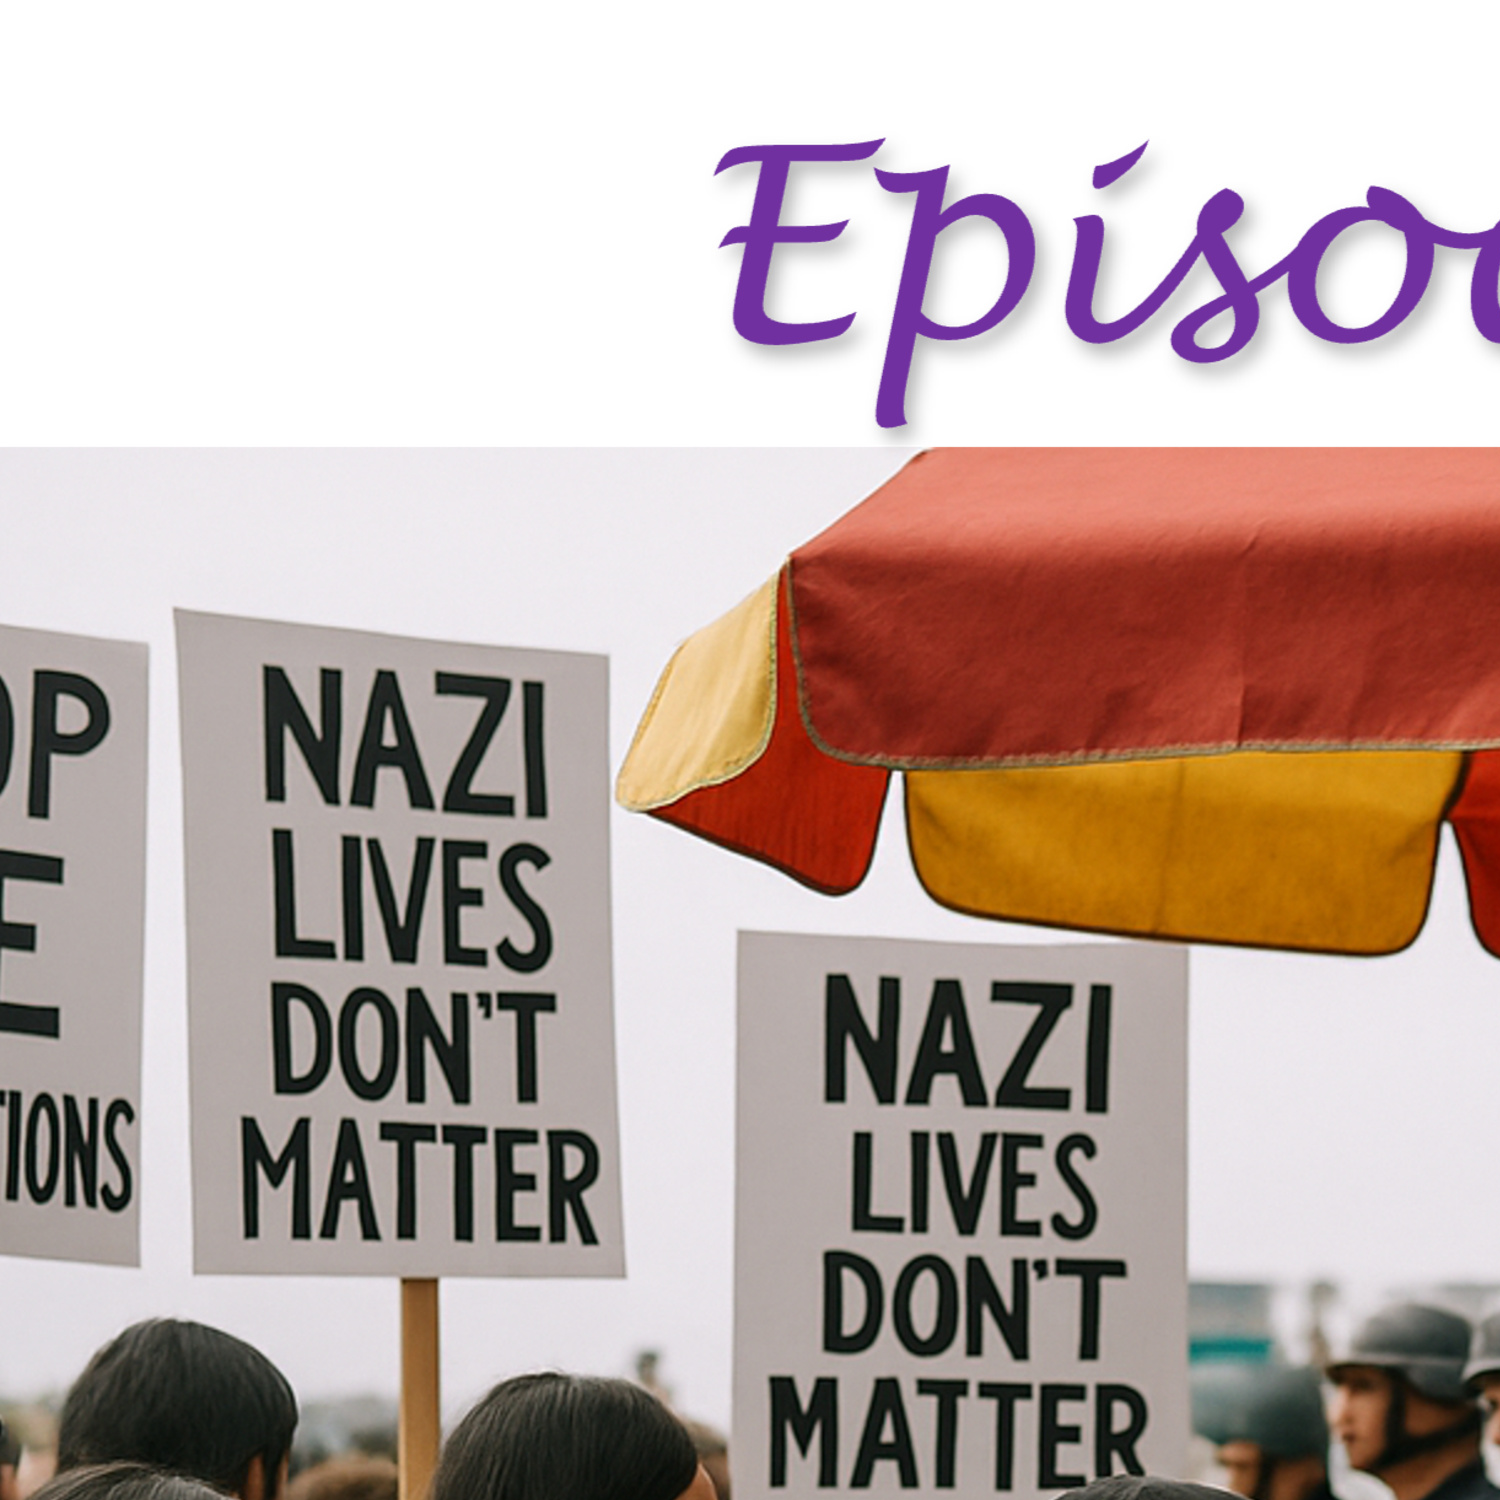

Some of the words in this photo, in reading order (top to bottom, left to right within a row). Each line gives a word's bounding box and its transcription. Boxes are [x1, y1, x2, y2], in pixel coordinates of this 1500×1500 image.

[0, 669, 111, 820] P
[263, 665, 548, 819] NAZI
[272, 828, 553, 974] LIVES
[271, 981, 557, 1106] DON'T
[824, 973, 1112, 1114] NAZI
[0, 1089, 135, 1213] IONS
[241, 1116, 600, 1246] MATTER
[852, 1130, 1098, 1241] LIVES
[823, 1250, 1127, 1361] DON'T
[768, 1375, 1148, 1492] MATTER
